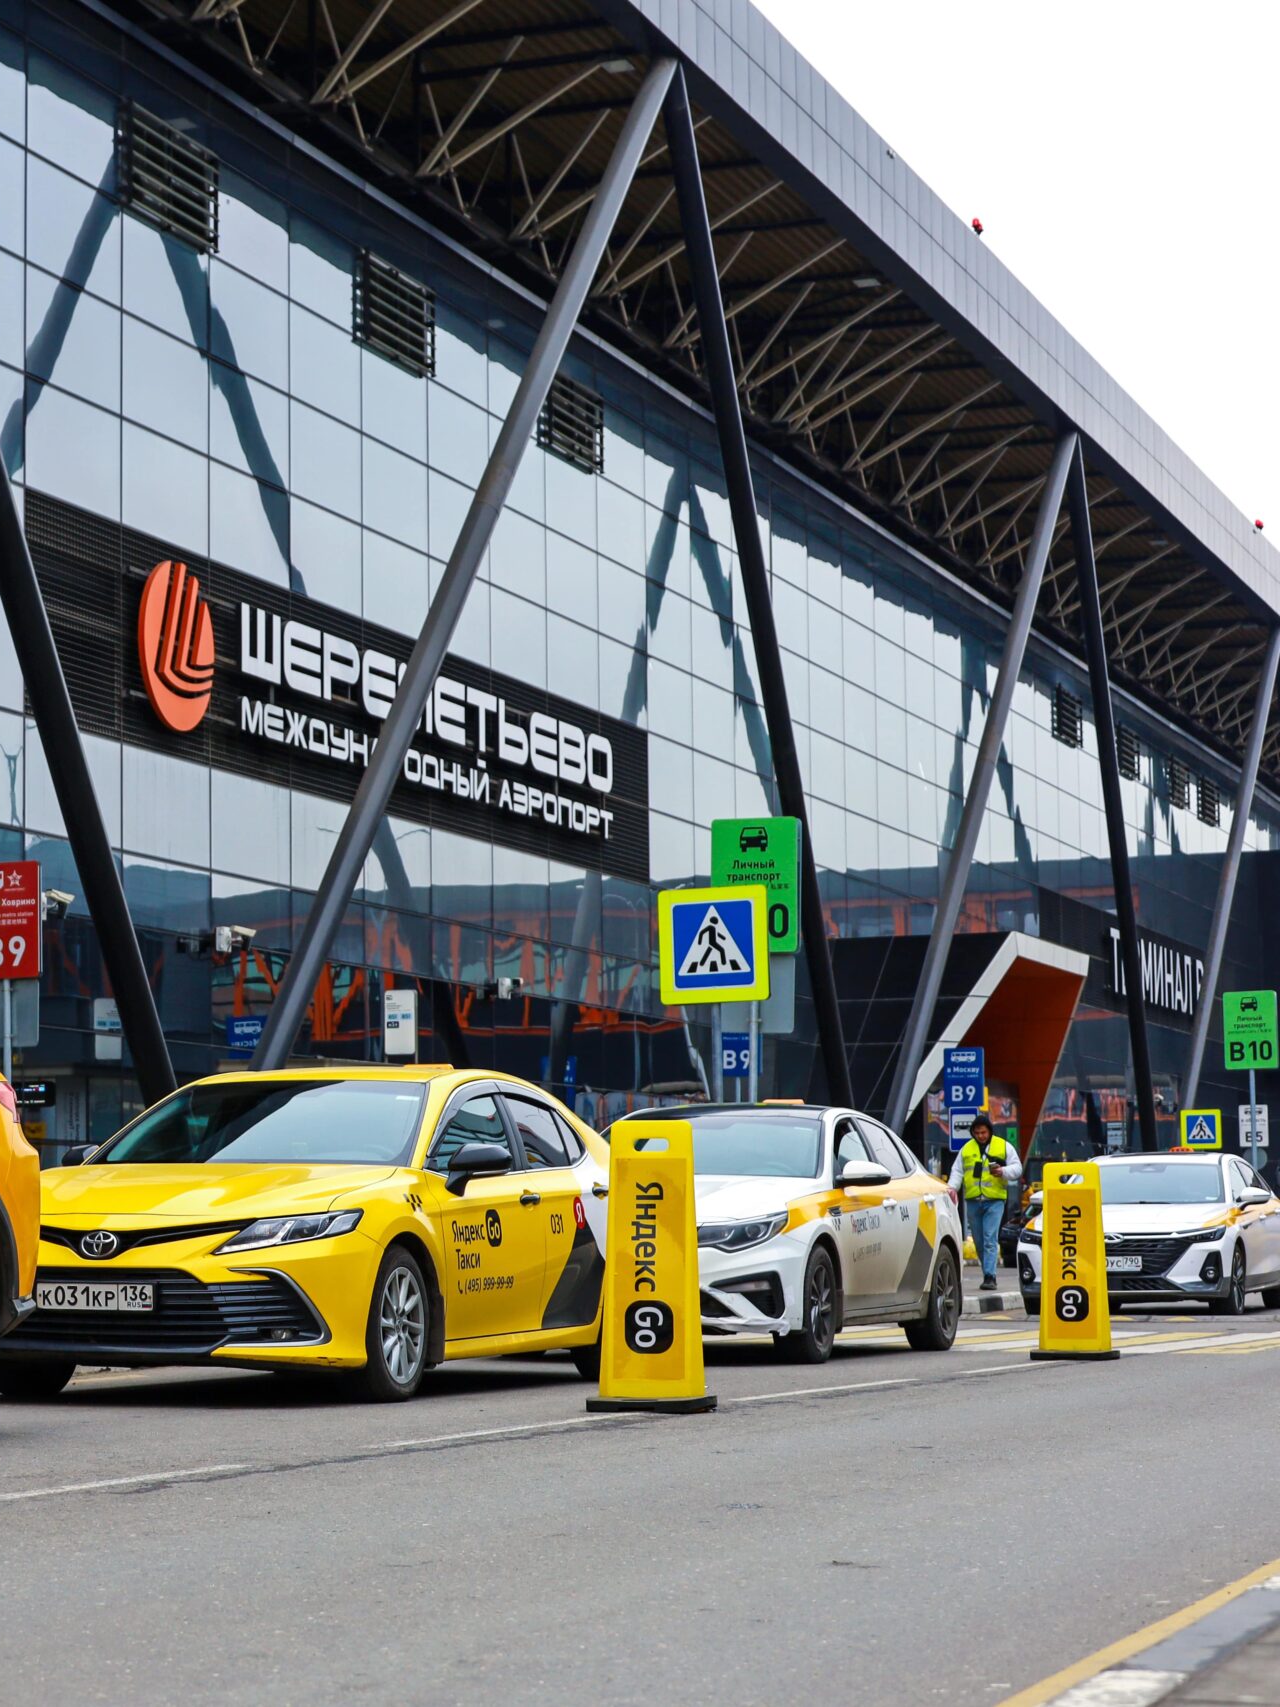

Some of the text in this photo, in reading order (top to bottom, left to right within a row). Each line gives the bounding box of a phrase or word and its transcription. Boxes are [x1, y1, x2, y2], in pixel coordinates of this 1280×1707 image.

[241, 696, 613, 839] МЕЖДУНОДНЫЙ АЭРОПОРТ
[732, 859, 775, 869] Личный
[727, 872, 781, 883] транспорт
[2, 898, 36, 908] Ховрино
[1110, 927, 1193, 1015] ТМИНАЛ
[952, 1066, 979, 1074] Москву
[451, 1217, 501, 1245] Яндекс Go
[550, 1213, 564, 1235] 031
[456, 1249, 480, 1270] Такси
[631, 1182, 664, 1348] Яндекс Go
[1059, 1205, 1082, 1318] Яндекс Go
[464, 1275, 515, 1294] (495) 999-99-99
[42, 1285, 148, 1307] К031КР 136
